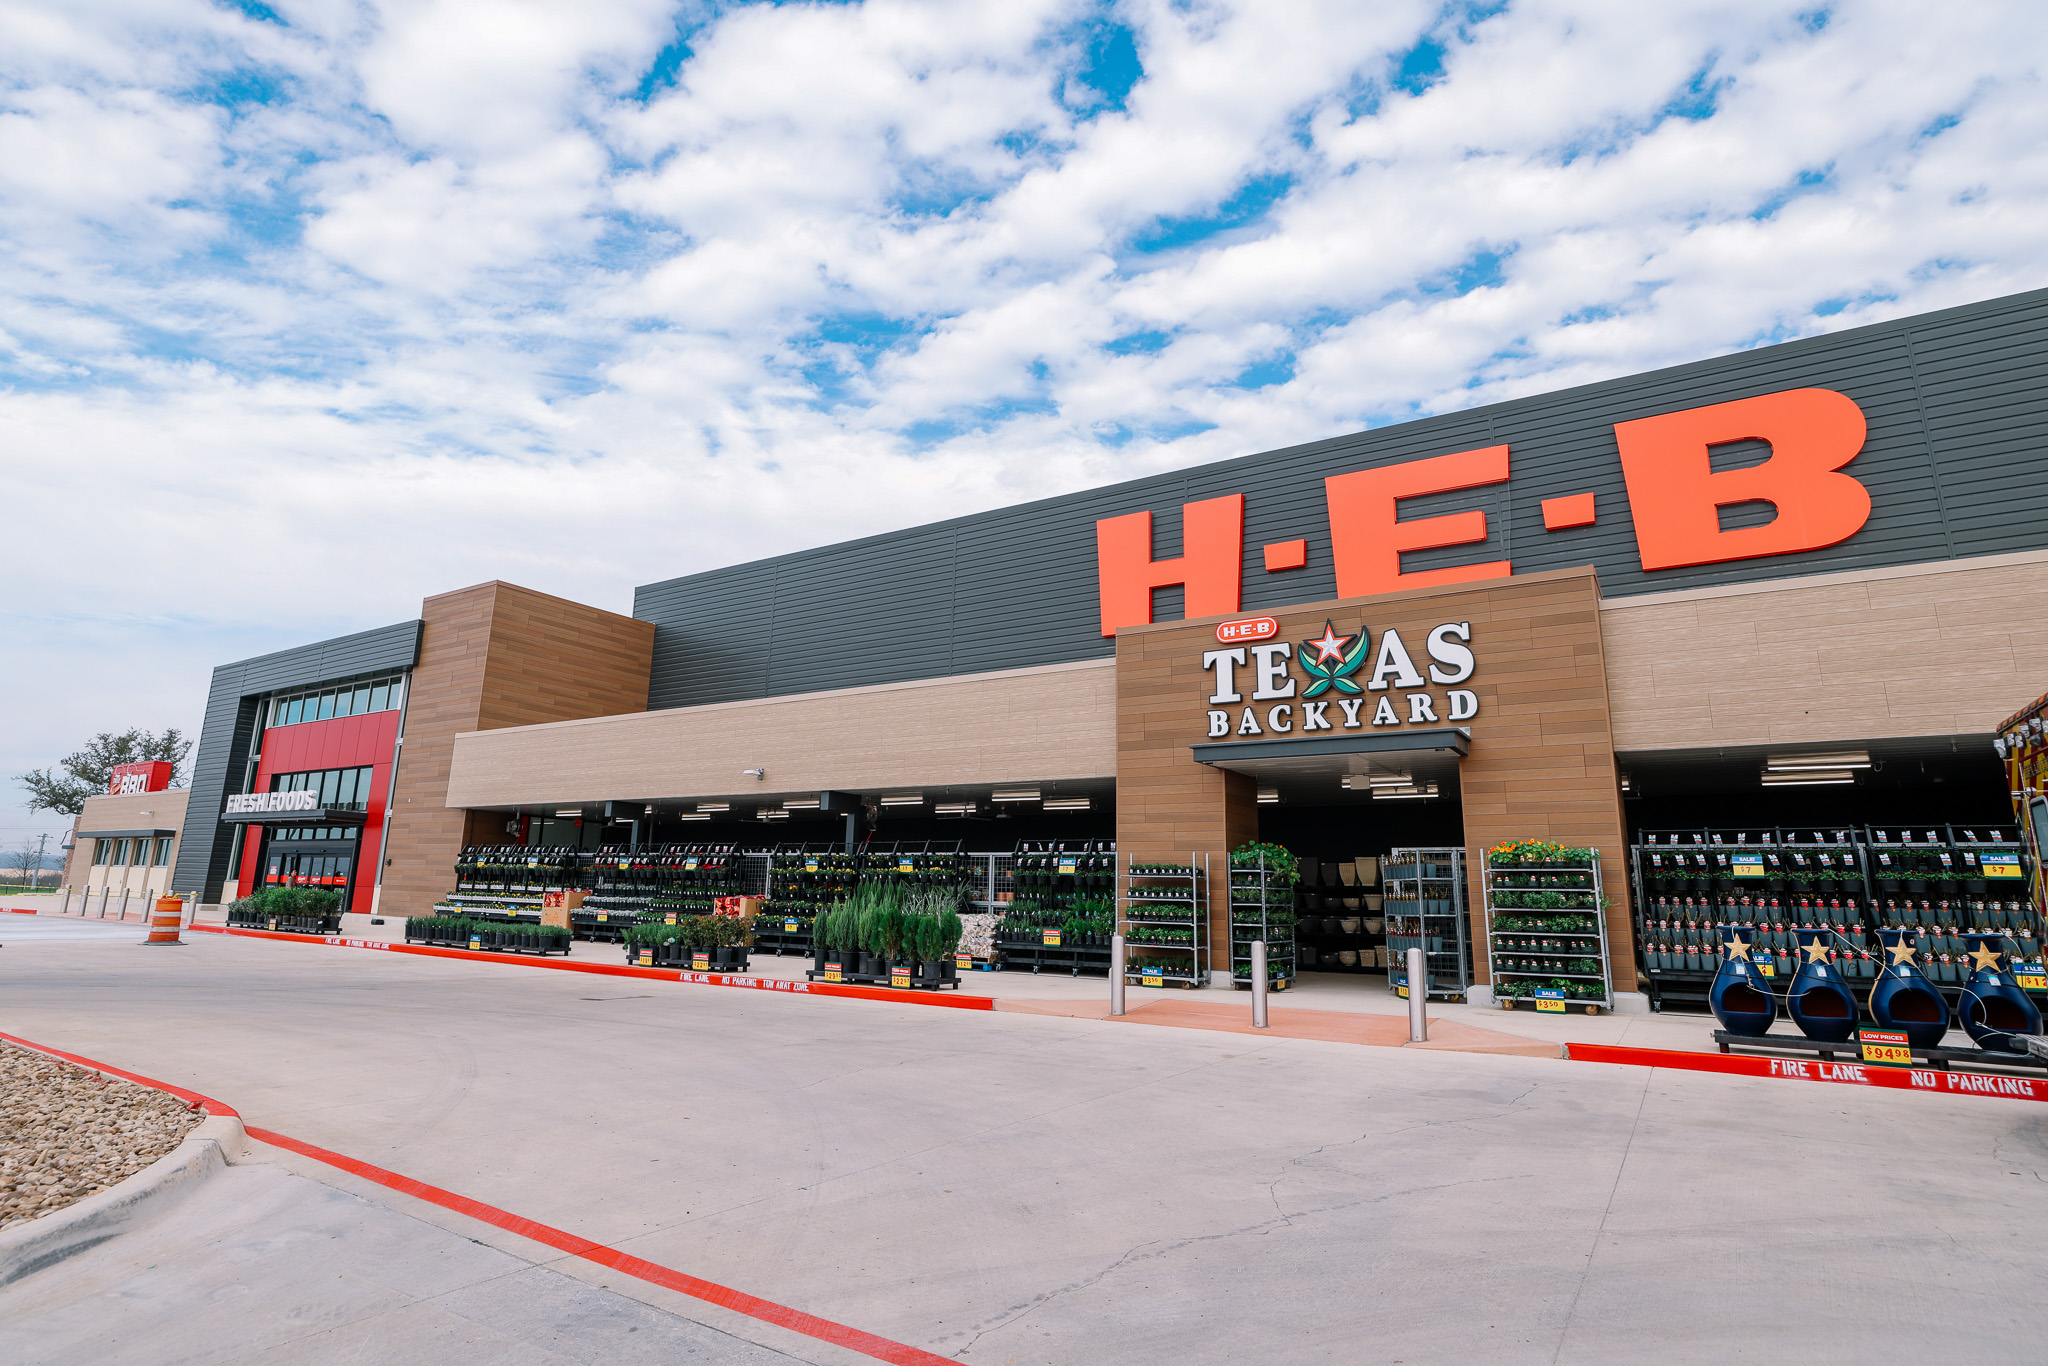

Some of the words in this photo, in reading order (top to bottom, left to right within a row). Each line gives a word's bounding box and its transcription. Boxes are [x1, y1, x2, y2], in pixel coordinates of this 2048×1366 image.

[1096, 387, 1871, 638] H-E-B
[1207, 688, 1480, 738] BACKYARD
[120, 773, 147, 795] BBQ
[226, 792, 270, 813] FRESH
[269, 789, 317, 811] FOODS
[1740, 866, 1752, 874] $7
[1992, 866, 2005, 874] $7
[680, 972, 692, 981] FIRE
[694, 974, 710, 982] LANE
[722, 976, 730, 984] NO
[732, 977, 757, 987] PARKING
[792, 982, 809, 992] ZONE
[1770, 1059, 1810, 1078] FIRE
[1818, 1063, 1868, 1082] LANE
[1910, 1070, 1936, 1087] NO
[1946, 1074, 2034, 1096] PARKING
